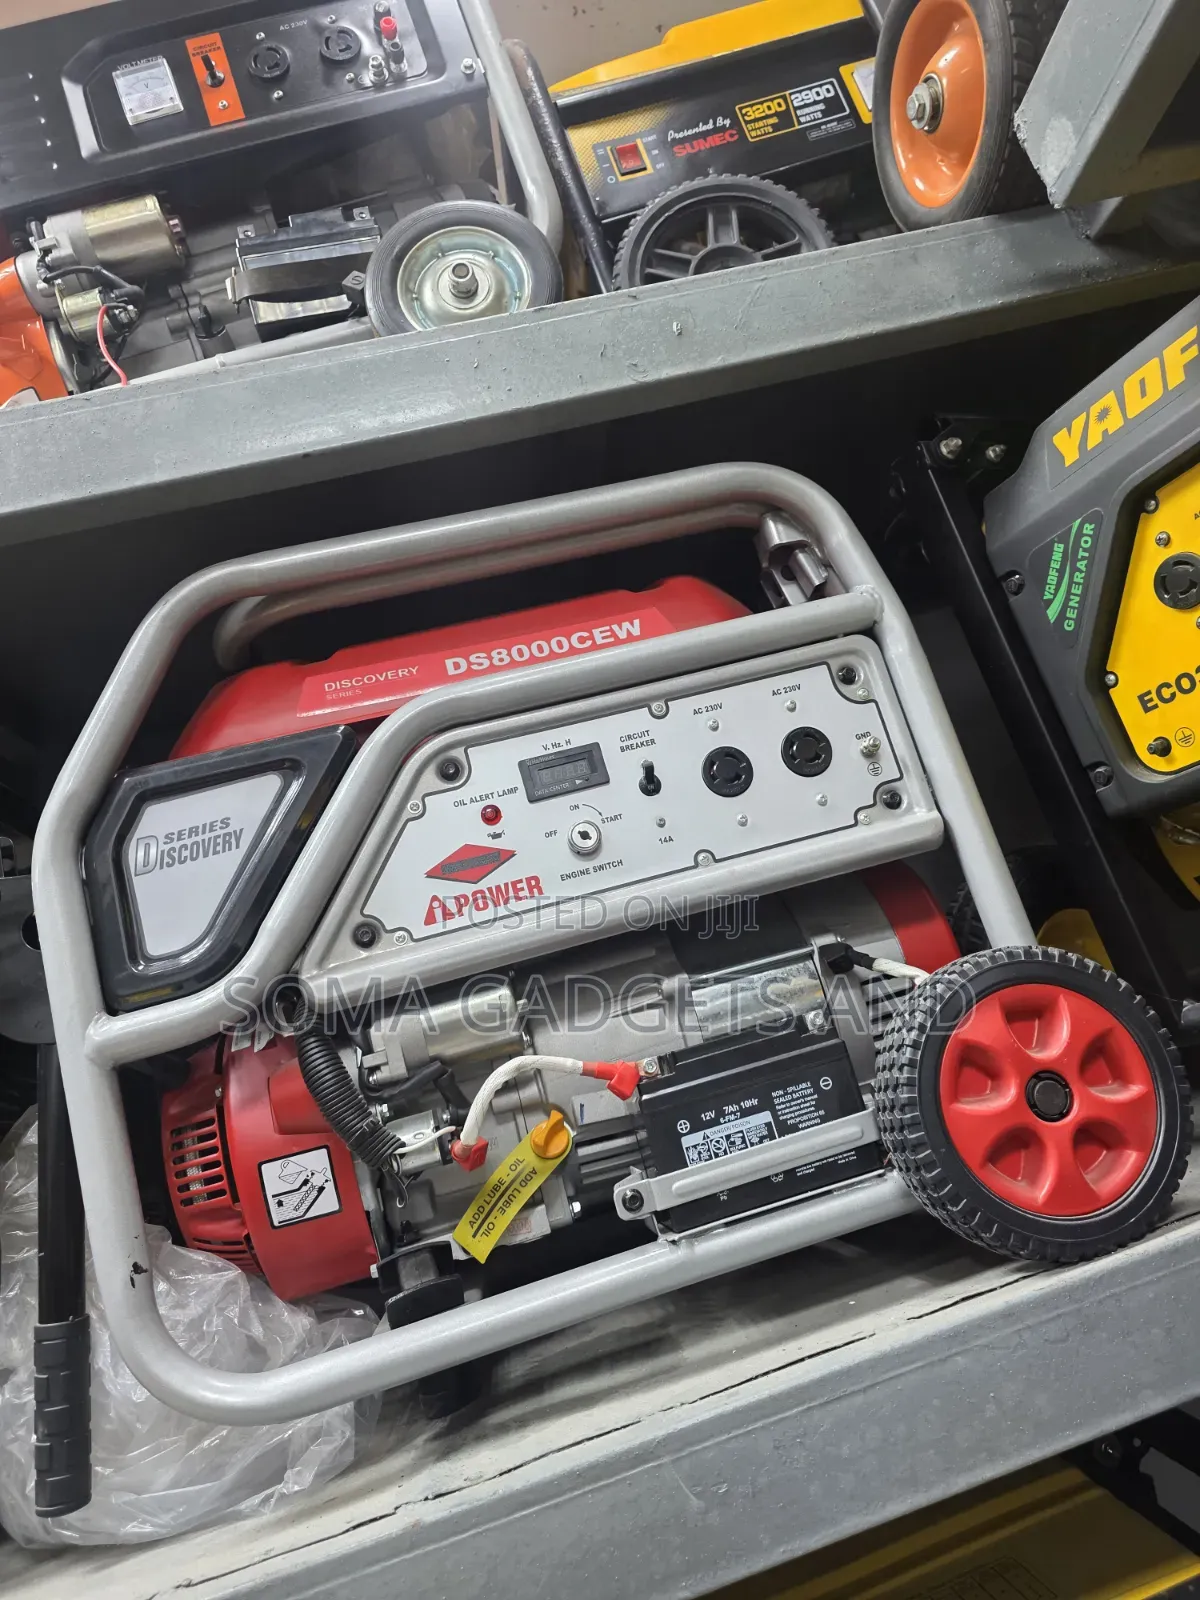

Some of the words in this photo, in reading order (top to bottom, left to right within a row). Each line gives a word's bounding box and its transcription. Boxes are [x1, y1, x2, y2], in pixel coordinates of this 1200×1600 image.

[291, 19, 308, 29] 230V
[192, 46, 222, 57] BREAKER
[193, 42, 218, 51] CIRCUIT
[790, 84, 836, 107] 2900
[741, 98, 787, 121] 3200
[796, 102, 826, 116] RUNNING
[799, 111, 823, 123] WATTS
[667, 119, 715, 141] Presented
[716, 116, 731, 127] By
[746, 116, 779, 130] STARTING
[749, 126, 773, 138] WATTS
[672, 129, 739, 157] SUMEC
[1052, 325, 1199, 467] YAOF
[1043, 542, 1065, 601] YAOFENG
[1063, 522, 1096, 631] GENERATOR
[444, 618, 641, 675] DS8000CEW
[324, 665, 420, 692] DISCOVERY
[326, 688, 362, 701] SERIES
[771, 689, 782, 697] AC
[782, 683, 801, 694] 230V
[693, 707, 704, 715] AC
[704, 702, 723, 713] 230V
[619, 729, 650, 743] CIRCUIT
[855, 731, 871, 741] GND
[619, 738, 657, 752] BREAKER
[453, 798, 468, 808] OIL
[469, 791, 495, 805] ALERT
[497, 786, 519, 798] LAMP
[535, 788, 549, 796] DATA
[549, 782, 570, 792] CENTER
[600, 813, 623, 824] START
[162, 816, 231, 845] SERIES
[544, 829, 558, 839] OFF
[658, 835, 674, 844] 14A
[134, 827, 244, 877] DISCOVERY
[560, 867, 592, 882] ENGINE
[592, 859, 624, 874] SWITCH
[771, 1089, 784, 1098] NON
[786, 1081, 812, 1093] SPILLABLE
[773, 1095, 792, 1105] SEALED
[792, 1088, 814, 1099] BATTERY
[701, 1110, 716, 1121] 12V
[723, 1103, 740, 1114] 7Ah
[740, 1098, 759, 1109] 10Hr
[519, 1166, 539, 1189] ADD
[468, 1205, 486, 1230] ADD
[485, 1176, 507, 1206] LUBE
[508, 1155, 526, 1172] OIL
[498, 1187, 522, 1216] LUBE
[480, 1221, 497, 1239] OIL
